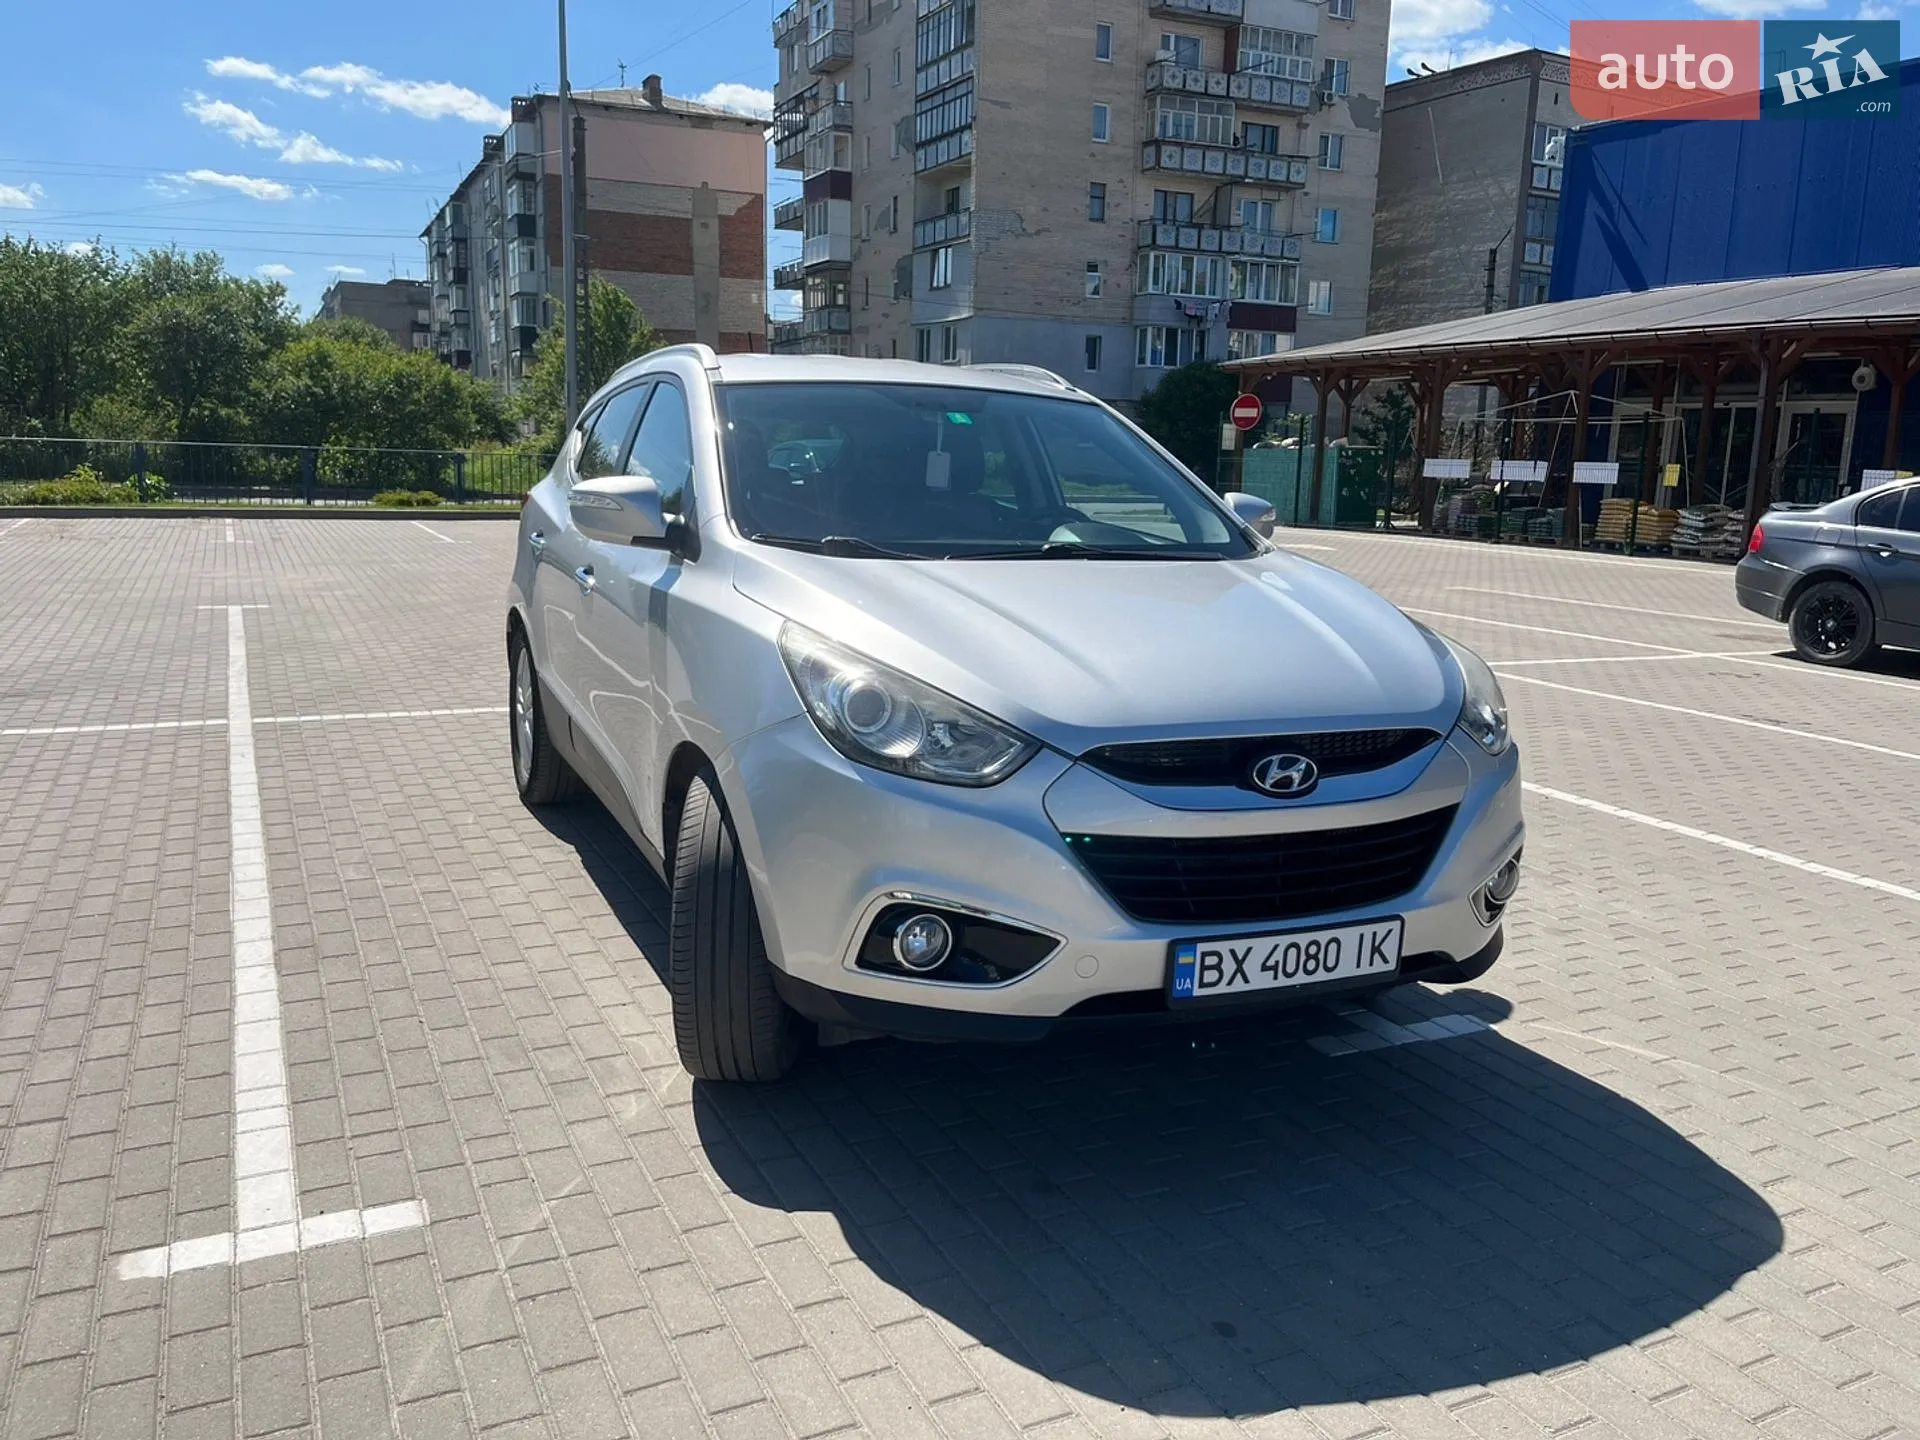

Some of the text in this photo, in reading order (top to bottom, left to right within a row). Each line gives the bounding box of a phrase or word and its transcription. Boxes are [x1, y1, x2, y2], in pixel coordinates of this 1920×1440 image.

[1197, 927, 1394, 989] BX 4080 IK
[1175, 978, 1192, 991] UA
